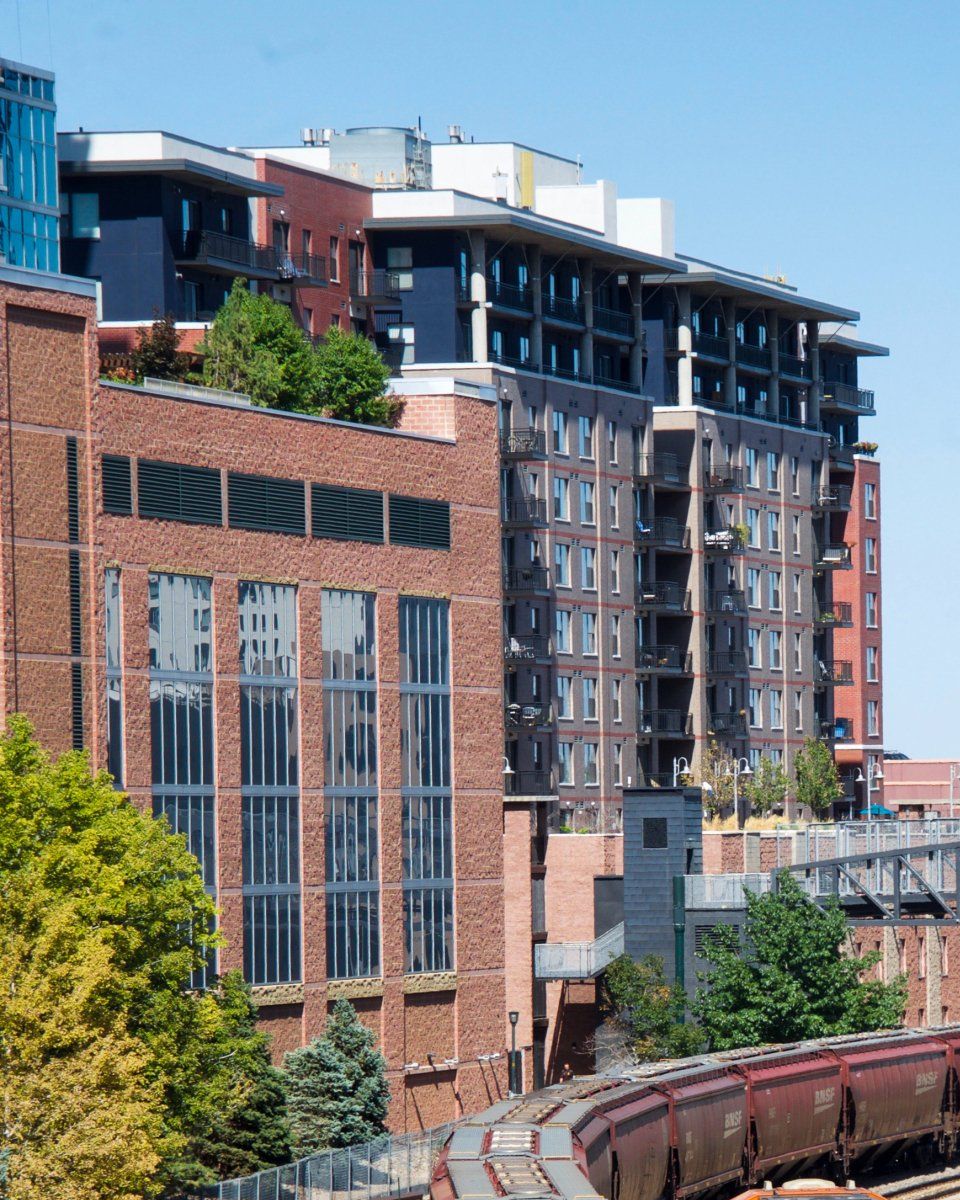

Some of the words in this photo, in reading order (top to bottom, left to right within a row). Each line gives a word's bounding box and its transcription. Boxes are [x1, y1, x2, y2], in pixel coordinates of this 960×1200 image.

[916, 1072, 938, 1087] BNSF
[815, 1087, 835, 1105] BNSF
[725, 1110, 743, 1128] BNSF
